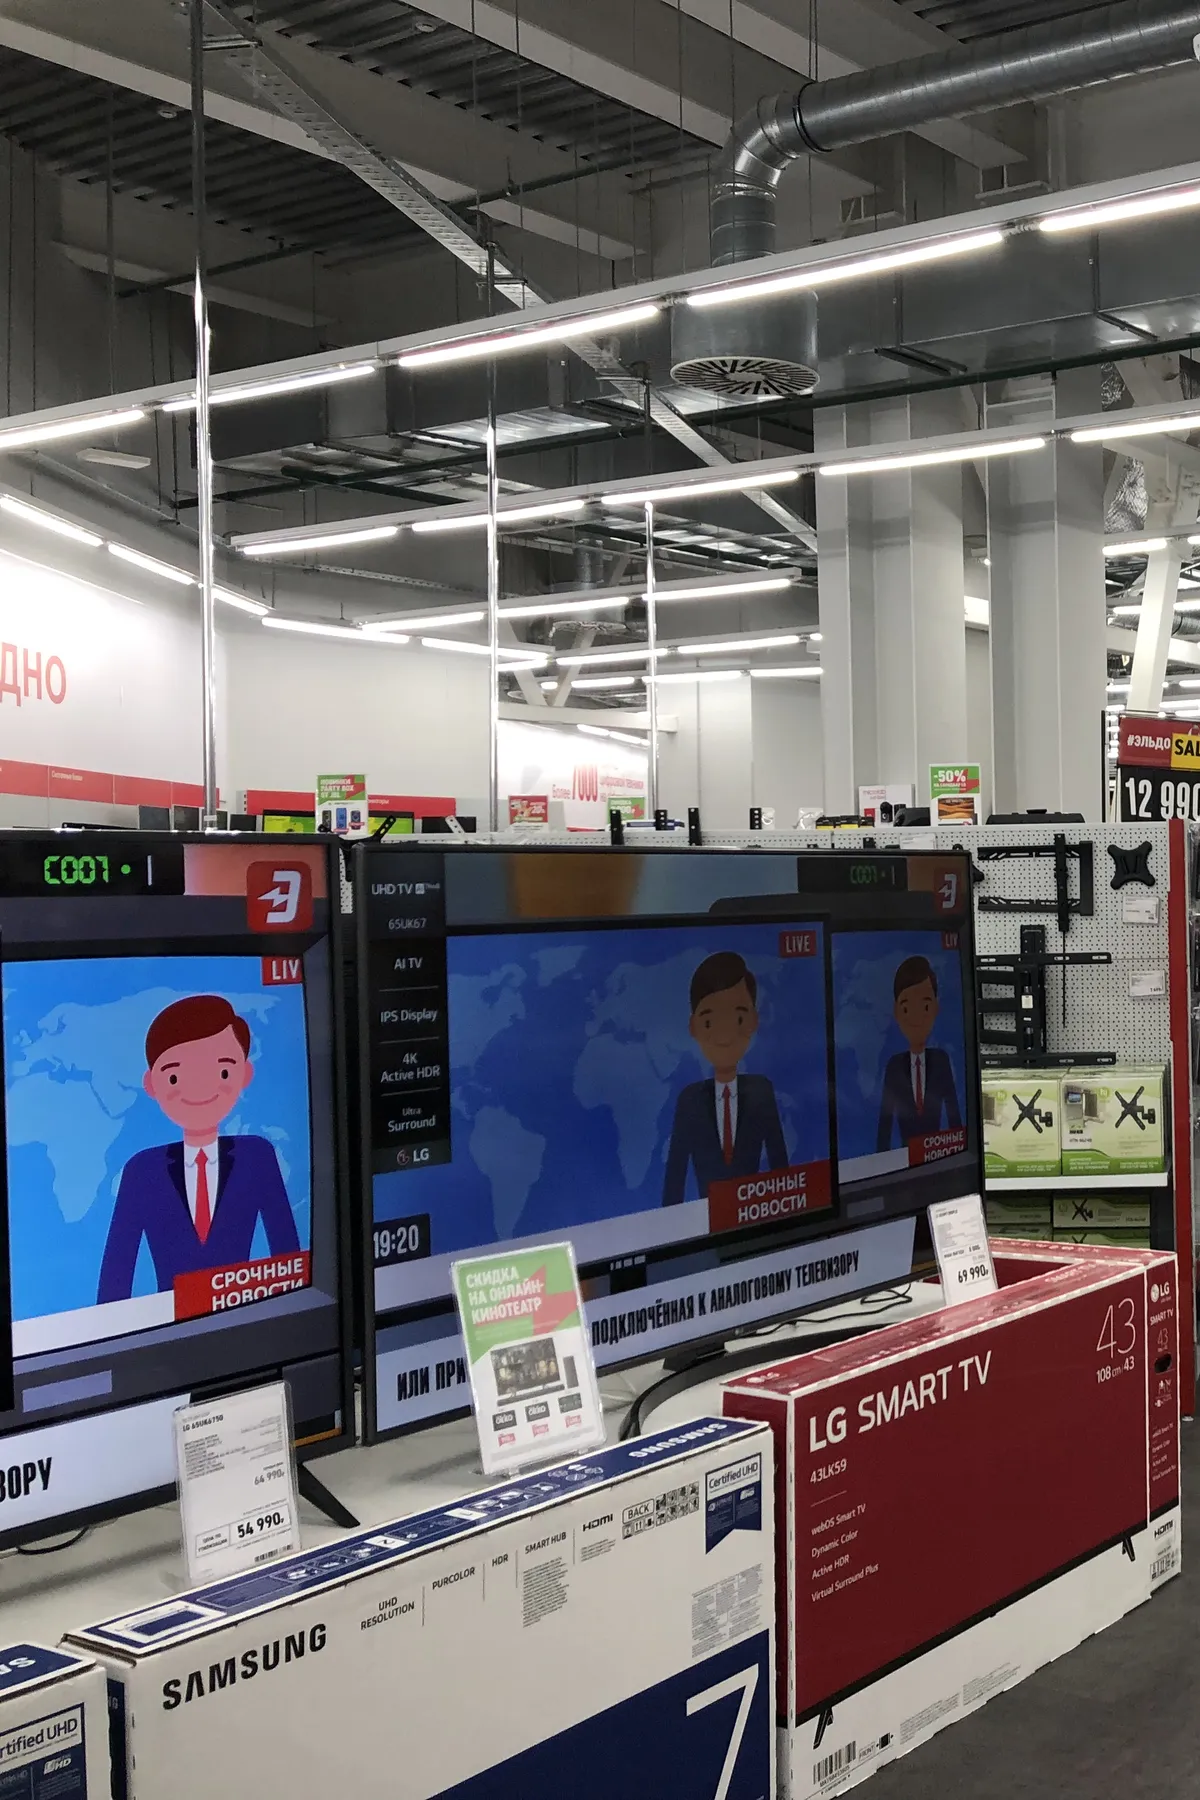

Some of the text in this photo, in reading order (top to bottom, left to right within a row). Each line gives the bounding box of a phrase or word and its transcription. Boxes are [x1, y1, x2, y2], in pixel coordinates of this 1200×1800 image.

[0, 642, 67, 706] ДНО
[933, 770, 966, 783] -50%
[1125, 777, 1152, 818] 12
[371, 883, 396, 895] UHD
[397, 882, 413, 895] TV
[388, 917, 427, 930] 65UK67
[785, 935, 810, 953] LIVE
[272, 959, 298, 980] LIV
[408, 958, 423, 969] TV
[380, 1009, 437, 1022] IPS Display
[402, 1052, 418, 1064] 4K
[381, 1065, 440, 1083] Active HDR
[388, 1117, 436, 1133] Surround
[413, 1148, 429, 1162] LG
[737, 1171, 806, 1201] СРОЧНЫЕ
[737, 1193, 806, 1223] НОВОСТИ
[374, 1224, 419, 1259] 19:20
[211, 1258, 303, 1290] СРОЧНЫЕ
[466, 1267, 519, 1288] СКИДКА
[958, 1269, 968, 1283] 69
[469, 1279, 544, 1306] НА ОНЛАЙН-
[1160, 1281, 1170, 1297] LG
[472, 1297, 542, 1324] КИНОТЕАТР
[397, 1368, 430, 1401] ИЛИ
[591, 1298, 694, 1345] ПОДКЛЮЧЁННАЯ
[710, 1274, 792, 1314] АНАЛОГОВОМУ
[796, 1250, 859, 1287] ТЕЛЕВИЗОРУ
[1096, 1298, 1136, 1358] 43
[1096, 1365, 1111, 1383] 108
[810, 1350, 992, 1453] LG SMART TV
[709, 1462, 758, 1488] Certified UHD
[810, 1458, 847, 1484] 43LK59
[583, 1513, 613, 1532] HDMI
[628, 1505, 650, 1520] BACK
[811, 1503, 866, 1535] webOS Smart TV
[237, 1522, 254, 1538] 54
[525, 1532, 567, 1555] SMART HUB
[811, 1529, 858, 1558] Dynamic Color
[492, 1554, 508, 1567] HDR
[812, 1554, 850, 1579] Active HDR
[432, 1566, 475, 1590] PURCOLOR
[811, 1563, 879, 1602] Virtual Surround Plus
[360, 1601, 415, 1630] RESOLUTION
[379, 1597, 397, 1611] UHD
[162, 1623, 327, 1710] SAMSUNG
[47, 1718, 78, 1740] UHD
[687, 1662, 759, 1800] 7
